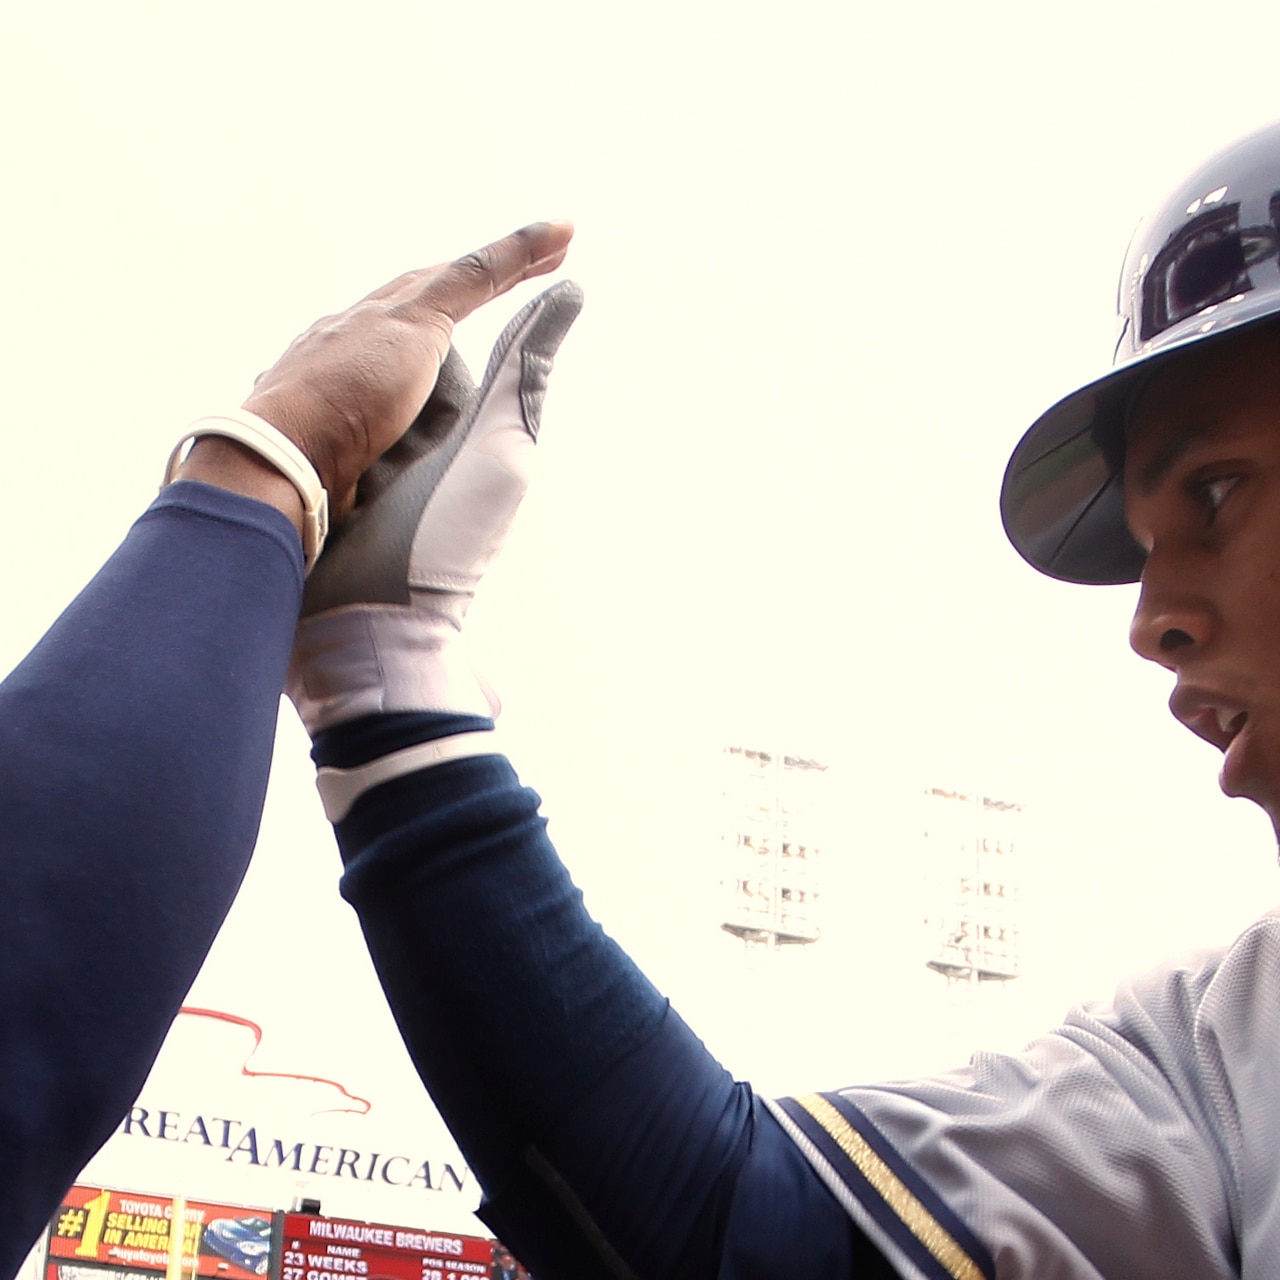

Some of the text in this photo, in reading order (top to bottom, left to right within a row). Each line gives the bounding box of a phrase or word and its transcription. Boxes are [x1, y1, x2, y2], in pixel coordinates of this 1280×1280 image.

[121, 1106, 470, 1192] REAT AMERICAN
[120, 1199, 206, 1223] TOYOTA CRY
[58, 1189, 111, 1258] #1
[106, 1212, 168, 1234] SELLING
[103, 1229, 122, 1245] IN
[309, 1220, 463, 1255] MILWAUKEE BREWERS
[284, 1251, 304, 1266] 23
[307, 1254, 368, 1274] WEEKS
[326, 1245, 361, 1257] NAME
[422, 1257, 486, 1274] POS SEASON
